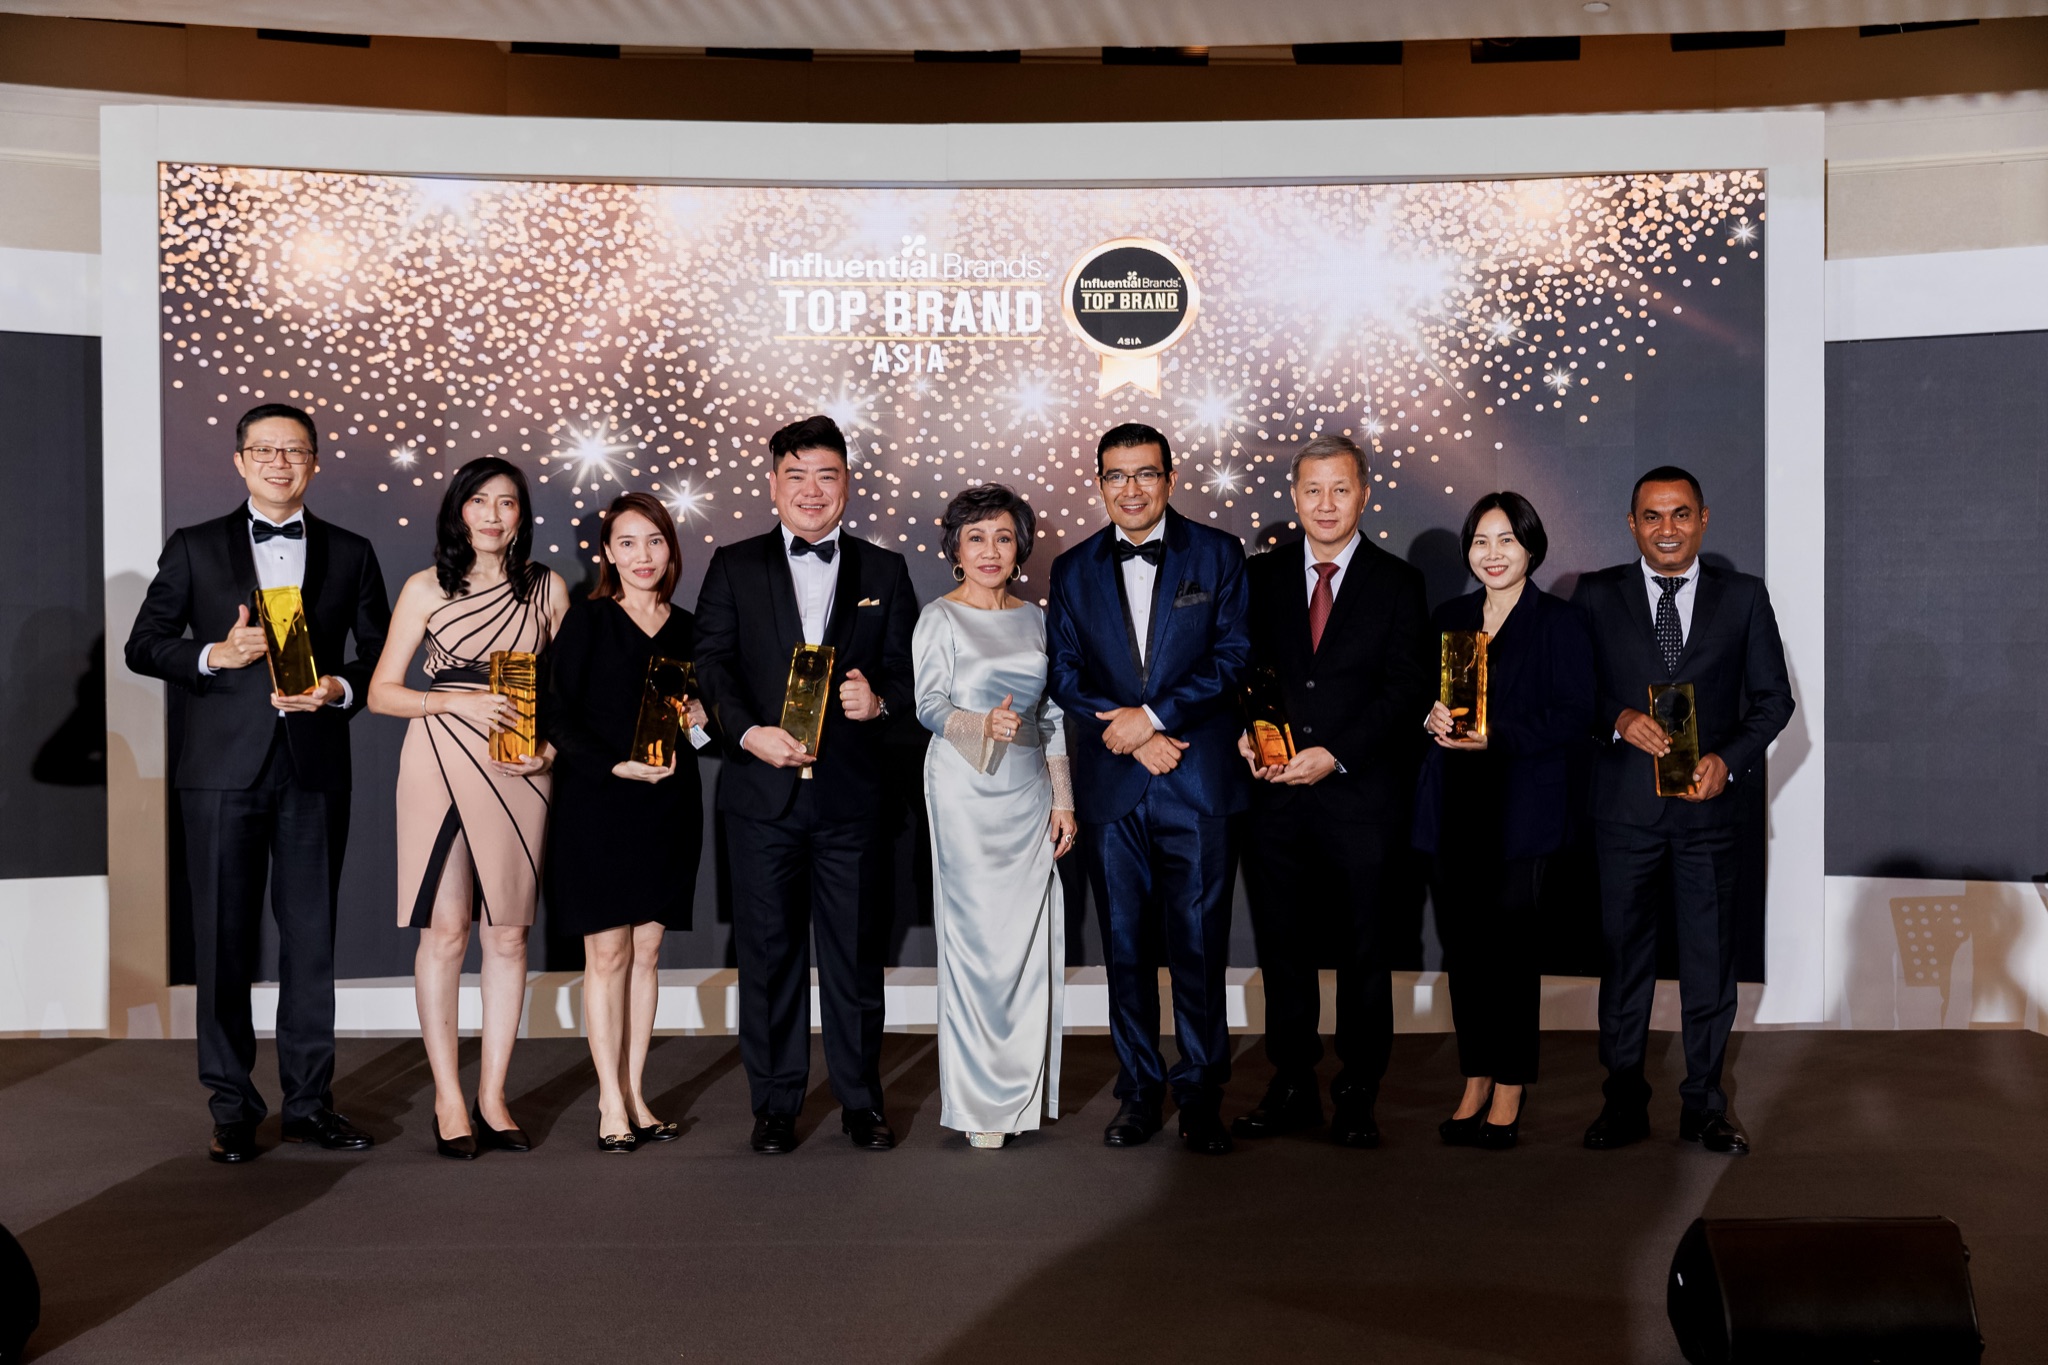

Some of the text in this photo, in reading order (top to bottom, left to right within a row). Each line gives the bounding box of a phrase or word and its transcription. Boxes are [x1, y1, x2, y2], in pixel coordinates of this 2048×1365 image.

[769, 251, 937, 278] Influential
[1080, 277, 1141, 289] Influential
[778, 289, 1043, 333] TOP BRAND
[1082, 292, 1178, 310] TOP BRAND
[1117, 336, 1142, 345] ASIA
[871, 342, 945, 374] ASIA
